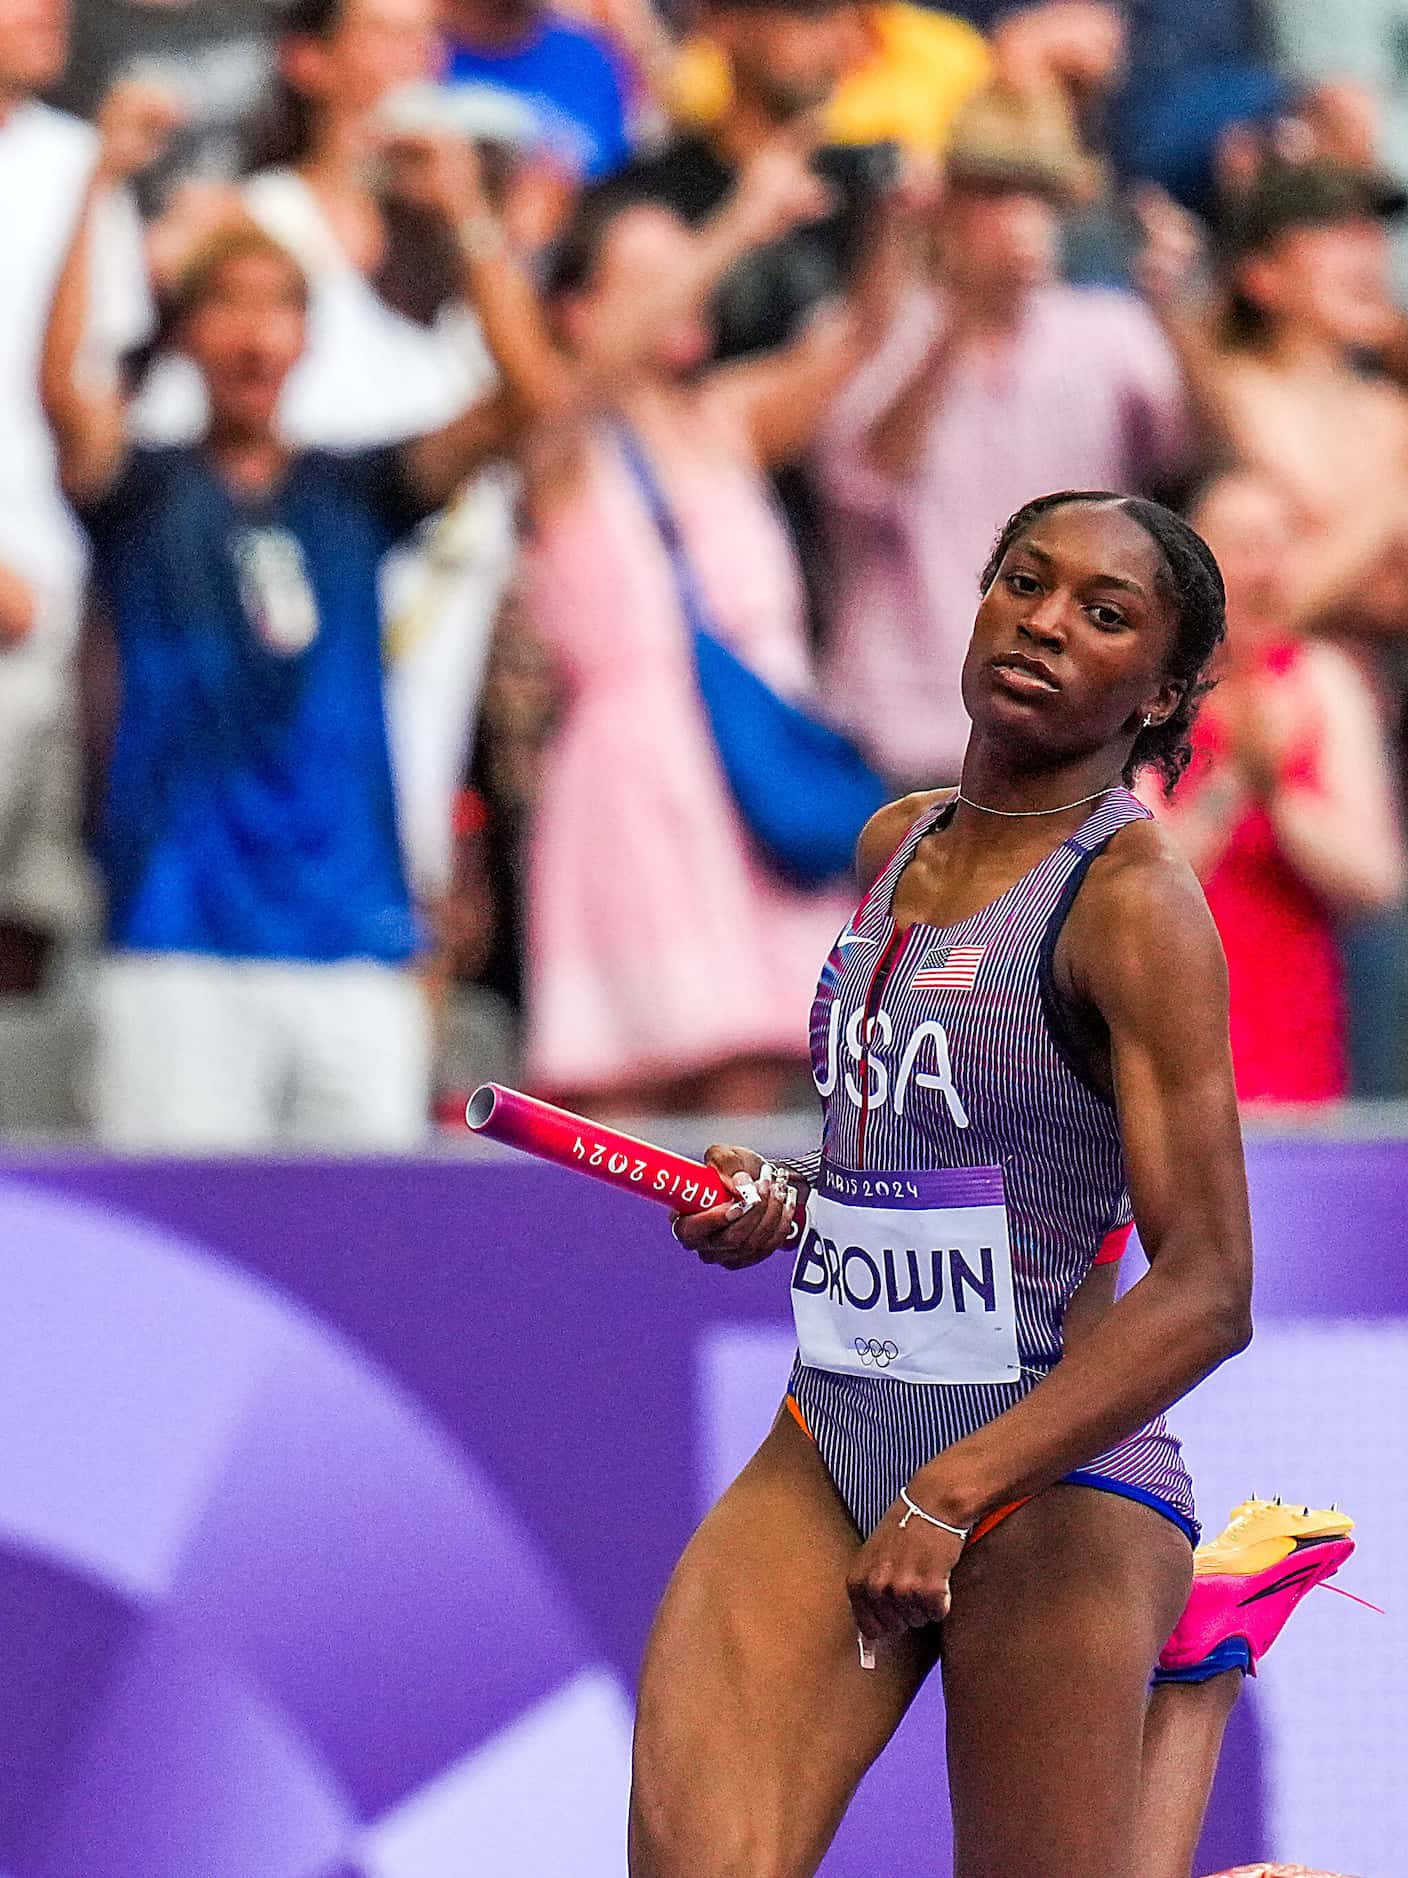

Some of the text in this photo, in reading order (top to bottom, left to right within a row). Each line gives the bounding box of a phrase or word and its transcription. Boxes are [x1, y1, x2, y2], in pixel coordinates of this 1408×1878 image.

[812, 998, 969, 1129] USA
[572, 1136, 648, 1182] 2024
[863, 1180, 918, 1198] 2024
[792, 1227, 996, 1313] BROWN
